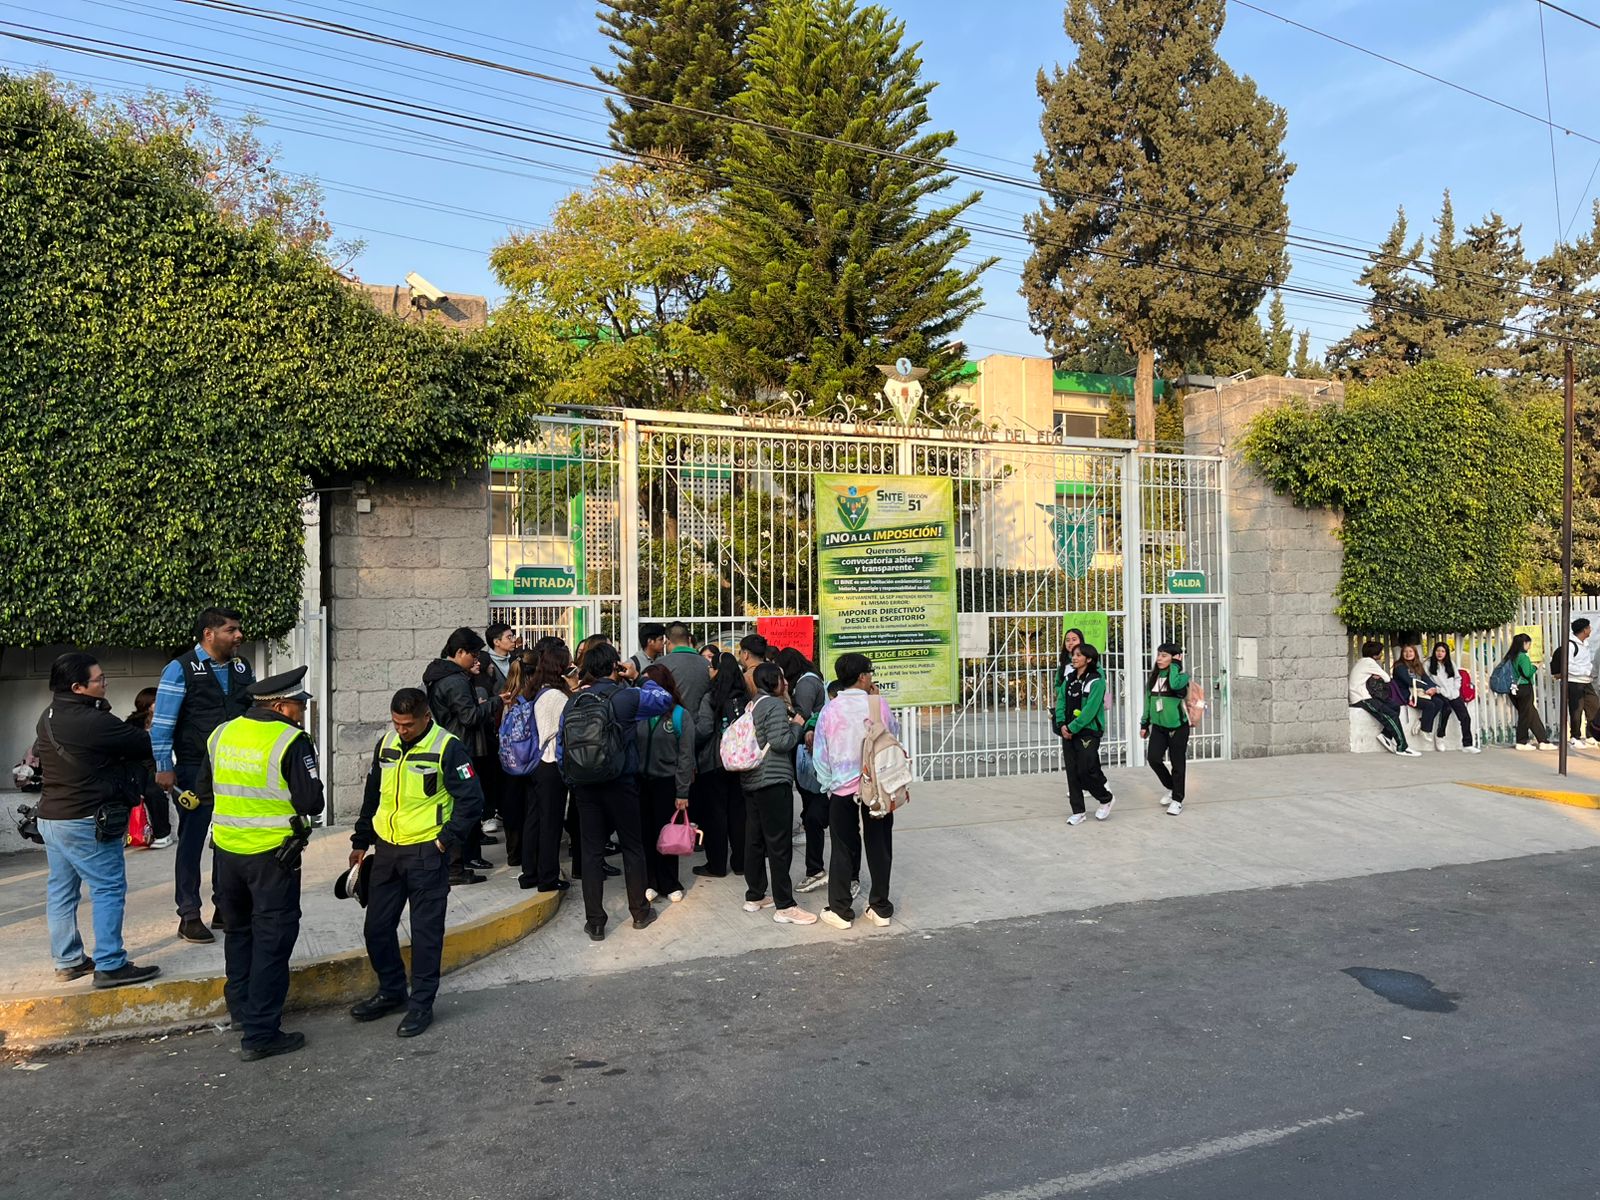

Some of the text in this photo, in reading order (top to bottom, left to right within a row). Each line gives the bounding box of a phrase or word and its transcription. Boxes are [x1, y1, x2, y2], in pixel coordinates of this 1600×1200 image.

[1005, 428, 1031, 443] DEL
[877, 490, 903, 502] SNTE
[908, 499, 921, 511] 51
[825, 533, 850, 545] ¡NO
[858, 533, 871, 541] LA
[873, 525, 942, 541] IMPOSICIÓN!
[865, 547, 906, 555] Queremos
[841, 555, 923, 566] convocatoria abierta
[855, 564, 915, 574] y transparente.
[513, 577, 574, 588] ENTRADA
[1172, 578, 1201, 588] SALIDA
[838, 606, 925, 617] IMPONER DIRECTIVOS
[880, 614, 925, 622] ESCRITORIO
[875, 650, 896, 659] EXIGE
[897, 649, 929, 657] RESPETO
[190, 661, 206, 671] M
